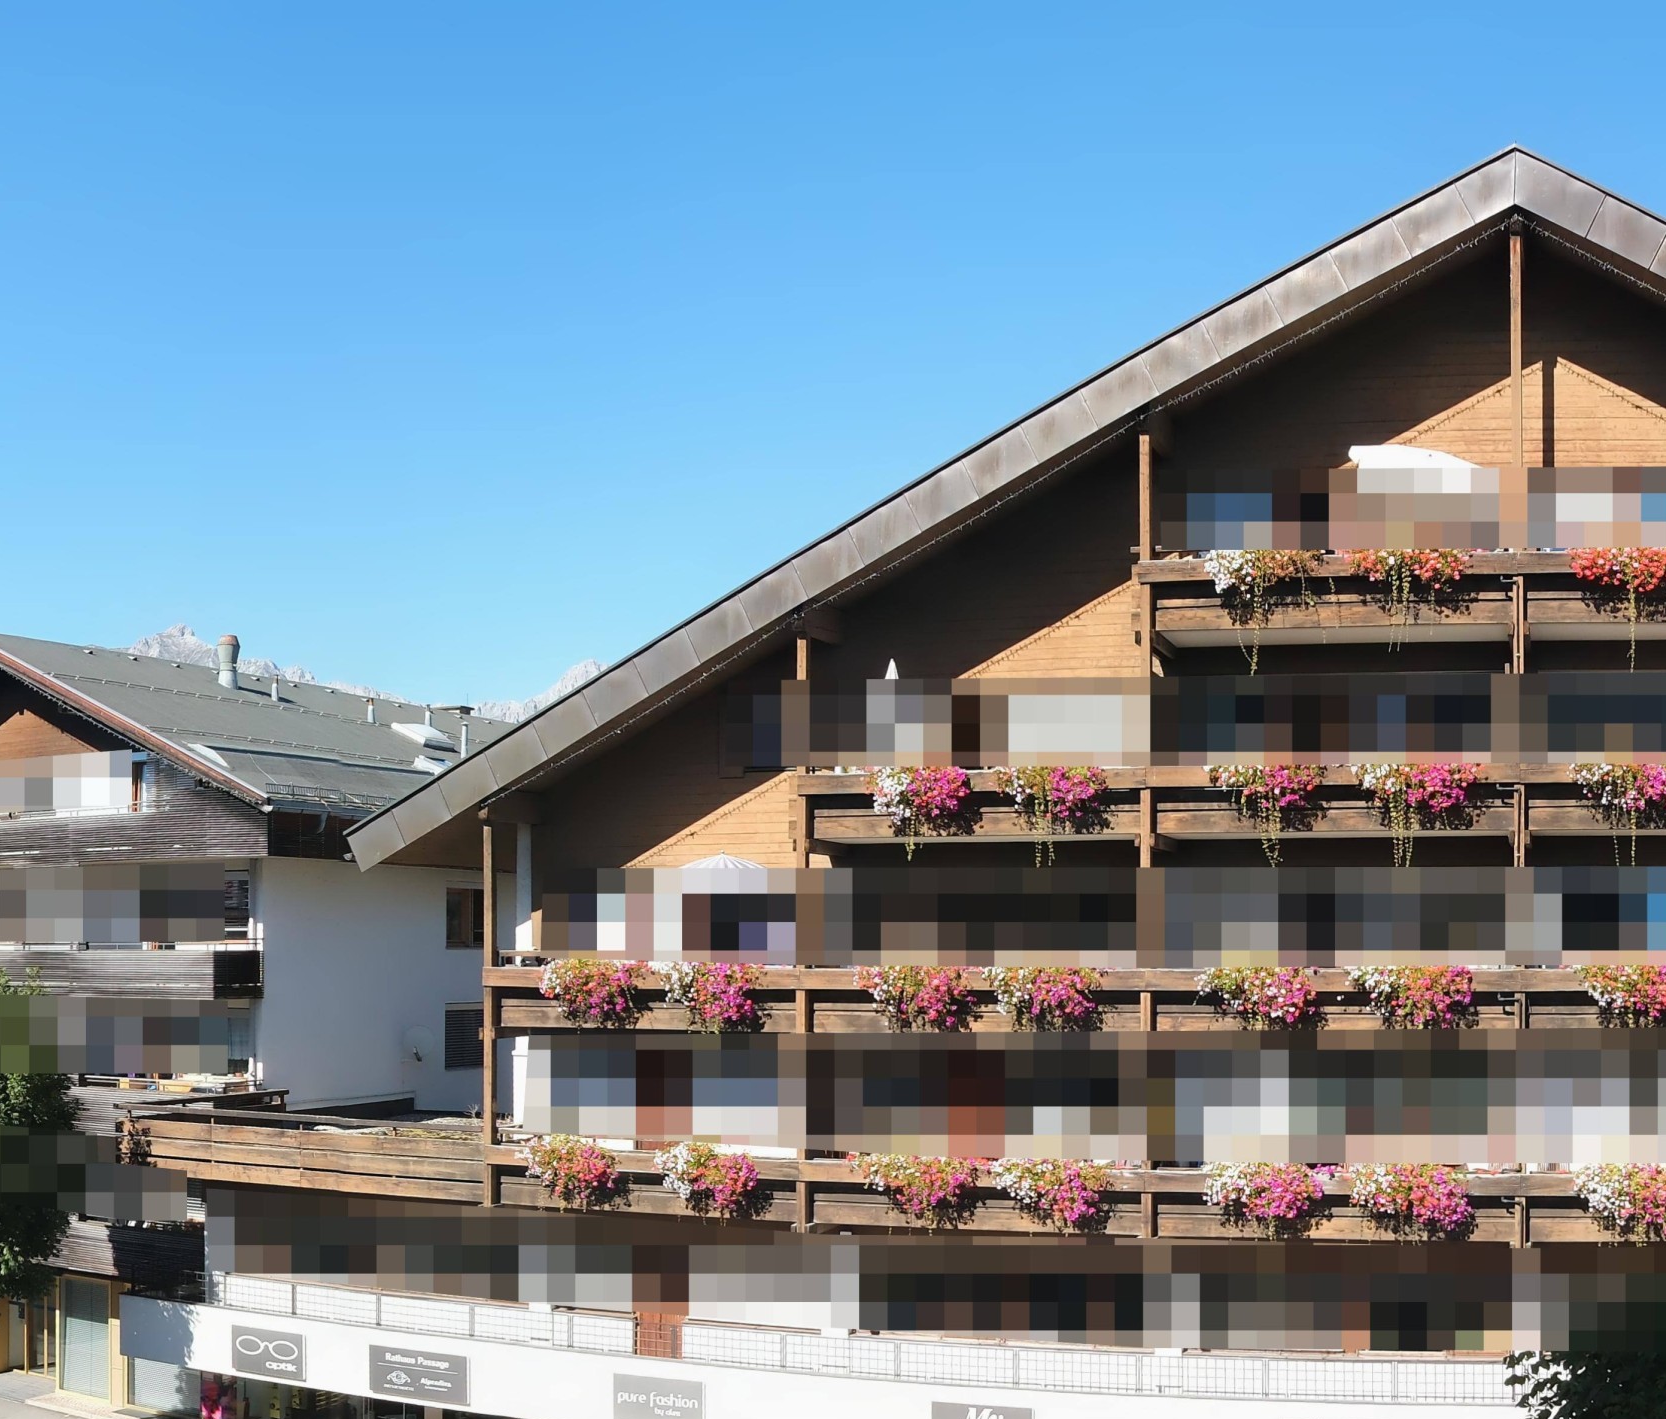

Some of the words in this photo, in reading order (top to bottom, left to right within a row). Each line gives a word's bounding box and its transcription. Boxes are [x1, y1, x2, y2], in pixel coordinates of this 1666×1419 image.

[265, 1360, 298, 1373] optik
[385, 1352, 416, 1364] Rathaus
[417, 1356, 450, 1370] Passage
[617, 1391, 647, 1404] pure
